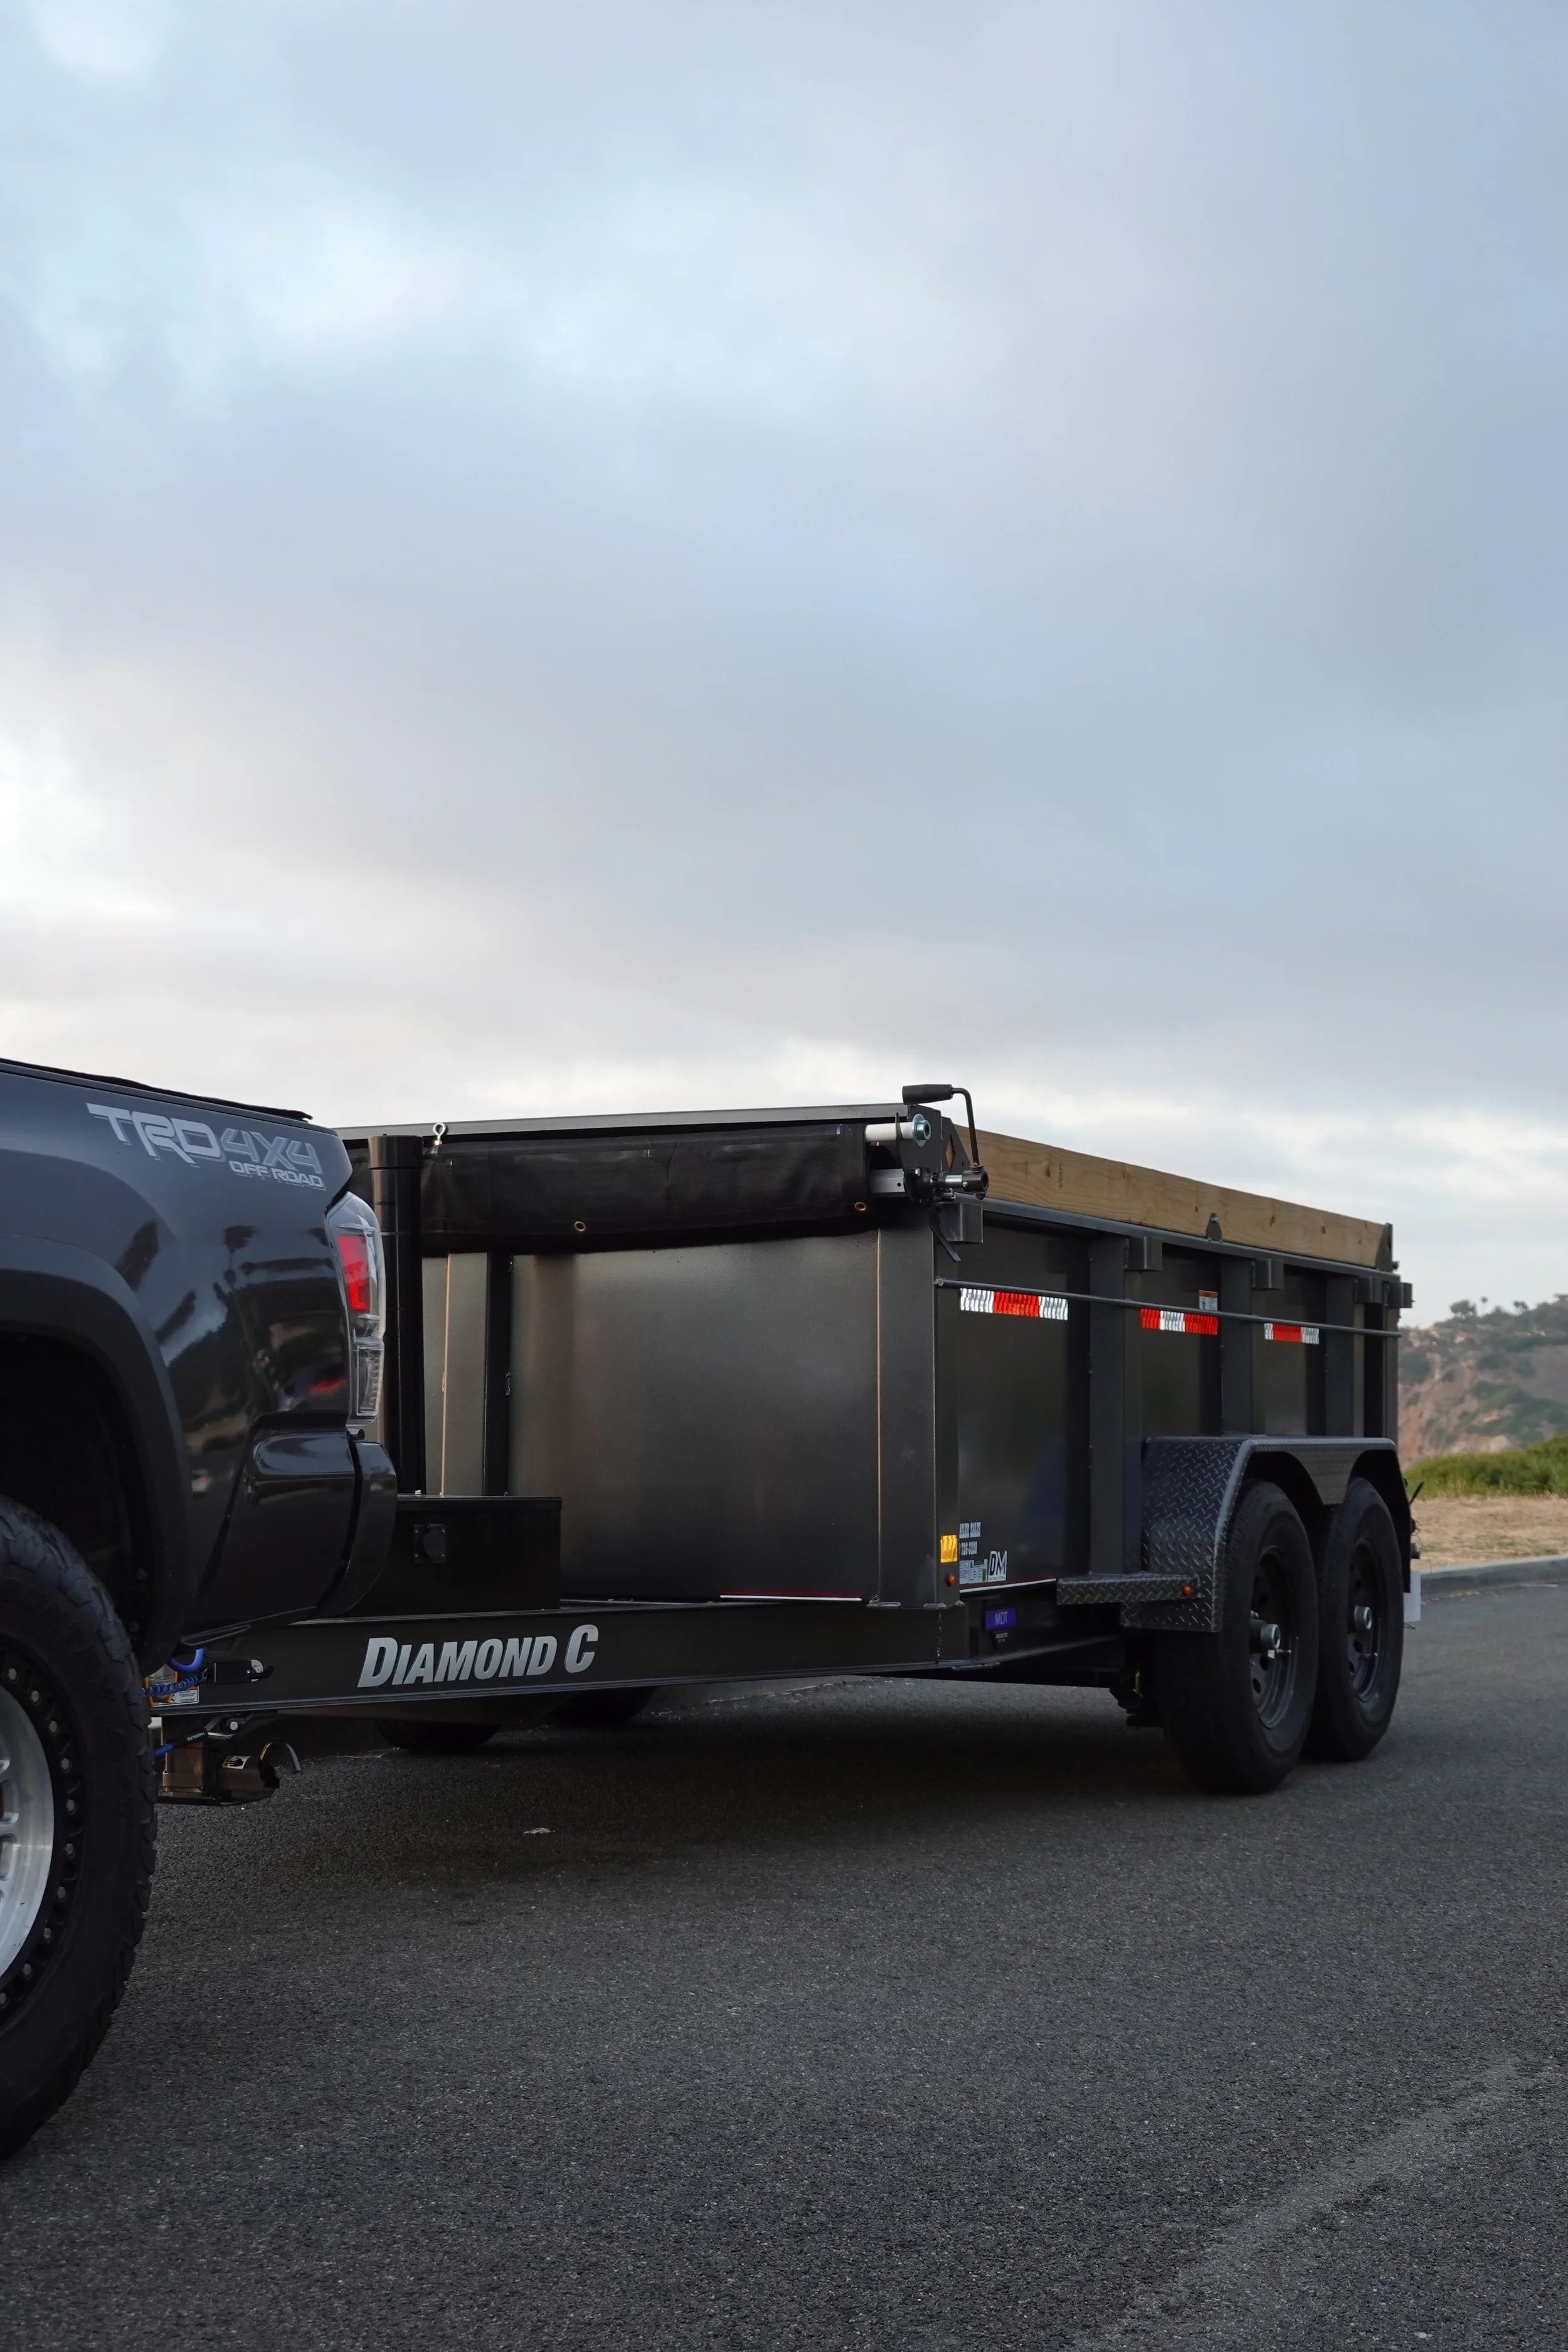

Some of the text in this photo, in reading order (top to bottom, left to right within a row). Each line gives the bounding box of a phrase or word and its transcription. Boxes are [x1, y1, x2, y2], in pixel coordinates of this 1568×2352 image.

[85, 1102, 224, 1167] TRD
[230, 1160, 326, 1190] OFF ROAD
[357, 1624, 599, 1688] DIAMOND C
